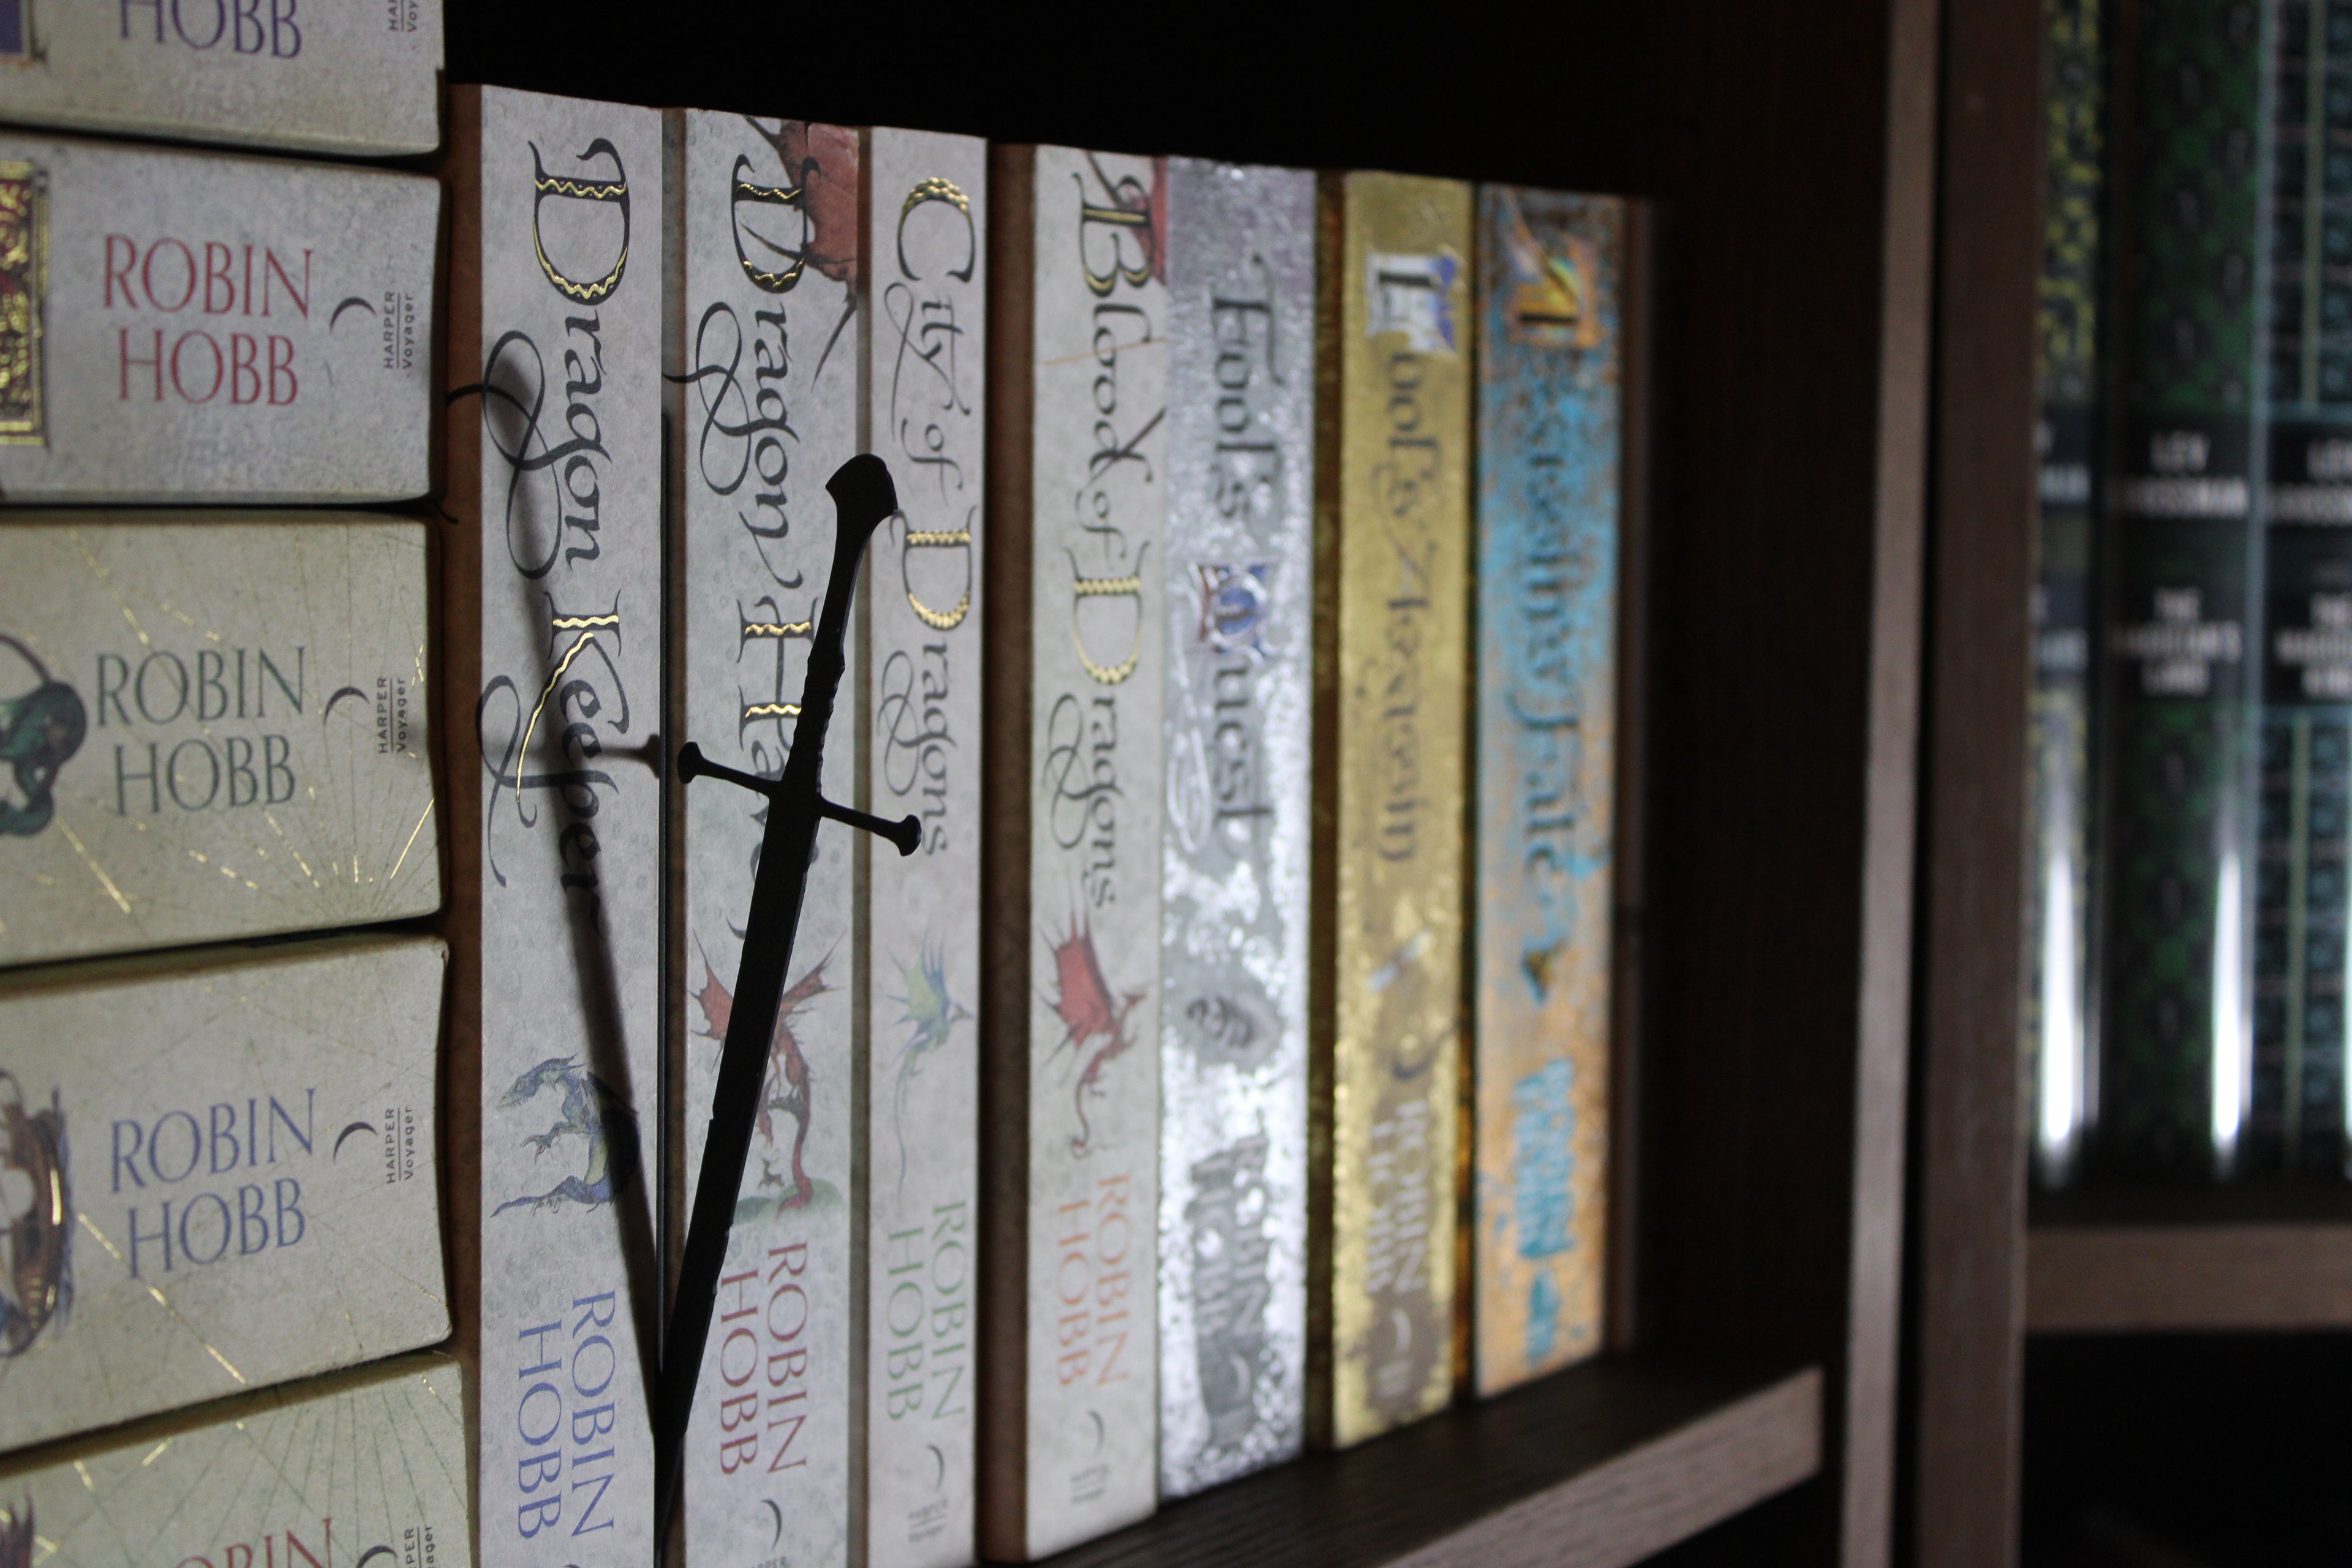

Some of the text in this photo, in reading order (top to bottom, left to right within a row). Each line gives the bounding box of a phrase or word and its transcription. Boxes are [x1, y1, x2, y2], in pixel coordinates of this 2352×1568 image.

[119, 0, 303, 58] HOBB
[103, 234, 314, 320] ROBIN
[384, 291, 395, 369] HARPER
[118, 328, 299, 406] HOBB
[402, 294, 414, 370] Voyager
[674, 154, 821, 588] Dragon
[475, 137, 630, 937] Dragon Keeper
[876, 176, 977, 856] City of Dragons
[1044, 172, 1166, 908] Blood of Dragons
[96, 646, 306, 728] ROBIN
[378, 676, 388, 754] HARPER
[396, 676, 407, 753] Voyager
[115, 735, 296, 817] HOBB
[110, 1088, 315, 1194] ROBIN
[385, 1107, 396, 1184] HARPER
[404, 1106, 413, 1181] Voyager
[128, 1177, 306, 1279] HOBB
[1095, 1174, 1133, 1387] ROBIN
[886, 1227, 924, 1421] HOBB
[931, 1200, 967, 1420] ROBIN
[1057, 1199, 1090, 1386] HOBB
[720, 1268, 758, 1475] HOBB
[767, 1240, 808, 1474] ROBIN
[518, 1319, 562, 1539] HOBB
[571, 1289, 616, 1537] ROBIN
